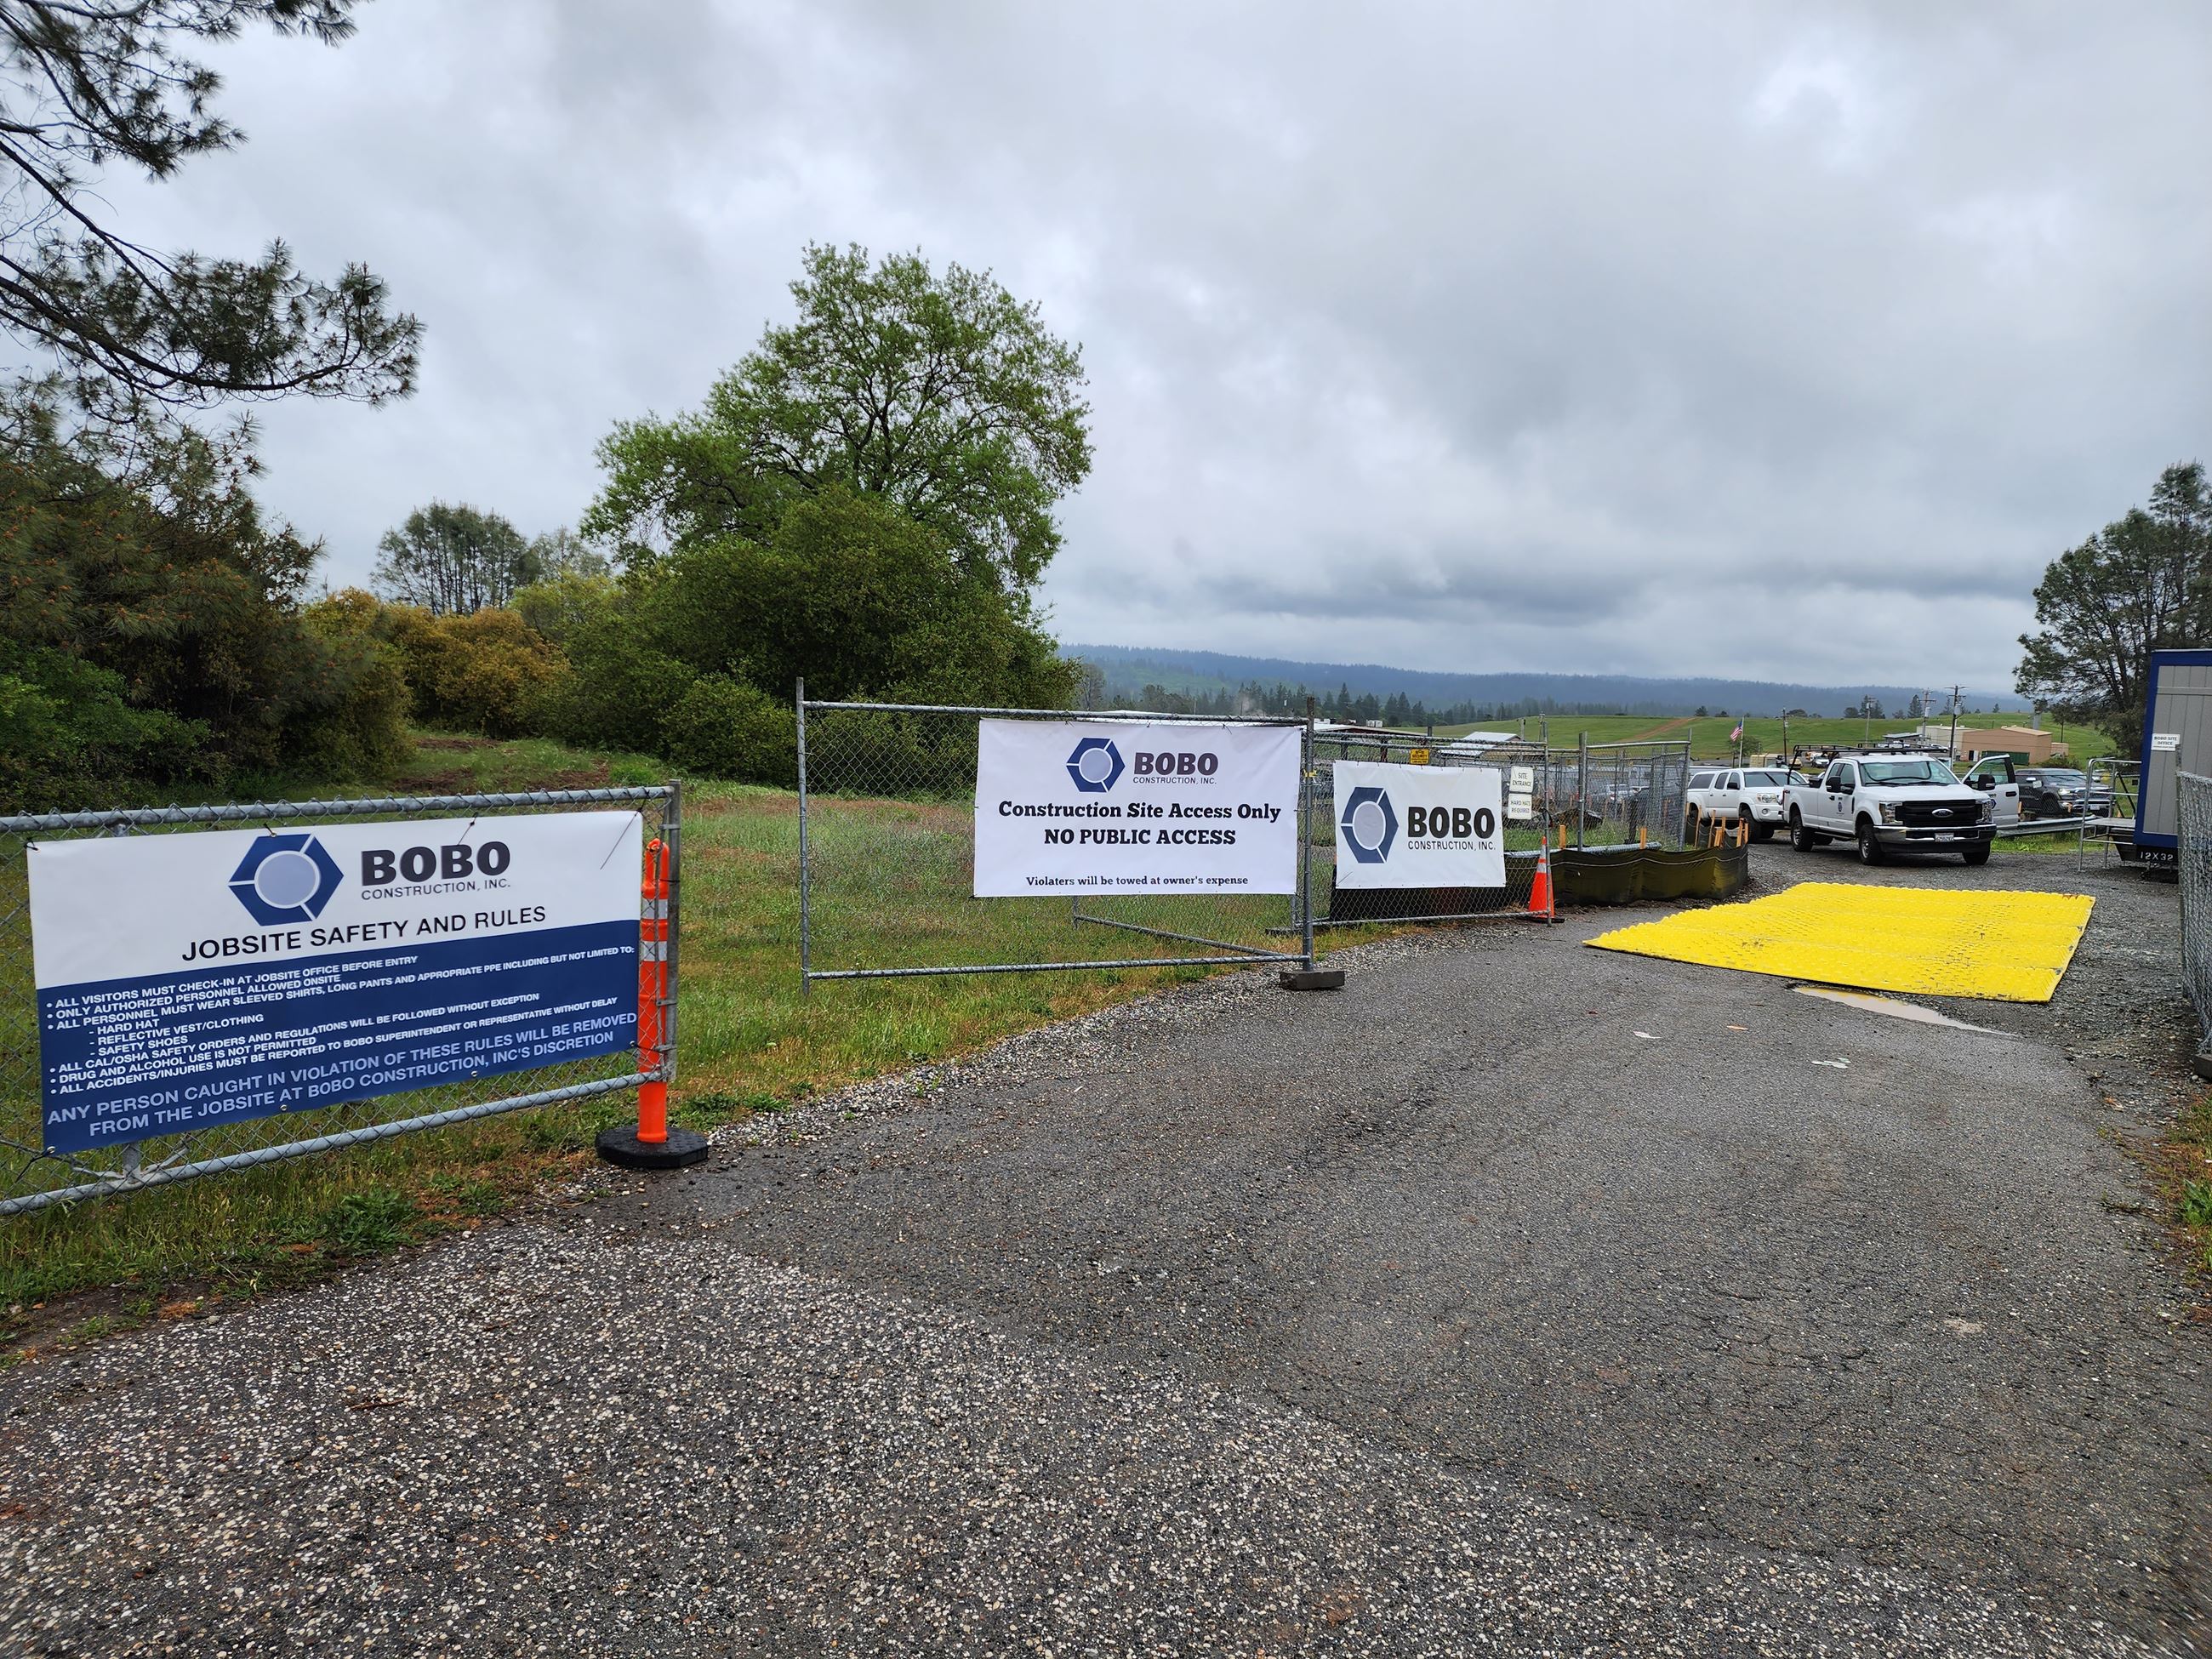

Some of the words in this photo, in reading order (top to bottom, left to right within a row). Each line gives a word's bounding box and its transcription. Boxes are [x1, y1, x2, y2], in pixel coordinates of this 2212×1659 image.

[1134, 752, 1218, 776] BOBO
[999, 801, 1122, 818] Construction
[1126, 801, 1164, 818] Site
[1168, 803, 1232, 818] Access
[1238, 803, 1281, 824] Only
[1408, 807, 1495, 839] BOBO
[1044, 829, 1075, 844] NO
[1080, 829, 1150, 844] PUBLIC
[1156, 830, 1236, 845] ACCESS
[1408, 841, 1477, 851] CONSTRUCTION,
[1479, 841, 1497, 850] INC.
[362, 841, 510, 887] BOBO
[2141, 852, 2174, 861] 12X32
[362, 881, 482, 901] CONSTRUCTION,
[484, 878, 511, 890] INC.
[1026, 876, 1075, 886] Violaters
[1077, 875, 1097, 885] will
[1100, 875, 1114, 885] be
[1116, 875, 1148, 885] towed
[1150, 876, 1160, 885] at
[1163, 875, 1203, 885] owner's
[1206, 877, 1248, 887] expense
[182, 931, 301, 961] JOBSITE
[311, 920, 408, 947] SAFETY
[416, 915, 466, 936] AND
[475, 905, 546, 929] RULES
[55, 998, 79, 1008] ALL
[82, 990, 139, 1004] VISITORS
[141, 985, 175, 997] MUST
[179, 978, 235, 992] CHECK-IN
[237, 976, 253, 985] AT
[255, 970, 300, 983] JOBSITE
[302, 965, 339, 977] OFFICE
[342, 961, 383, 972] BEFORE
[385, 955, 419, 966] ENTRY
[56, 1019, 80, 1030] ALL
[83, 1009, 157, 1026] PERSONNEL
[161, 1003, 194, 1016] MUST
[197, 999, 231, 1011] WEAR
[233, 992, 283, 1006] SLEEVED
[286, 986, 325, 999] SHIRTS,
[328, 982, 357, 993] LONG
[359, 977, 393, 989] PANTS
[394, 975, 415, 984] AND
[417, 966, 482, 982] APPROPRIATE
[484, 964, 502, 972] PPE
[503, 956, 549, 970] INCLUDING
[550, 955, 567, 963] BUT
[568, 952, 586, 961] NOT
[587, 947, 619, 958] LIMITED
[56, 1006, 91, 1019] ONLY
[94, 996, 173, 1014] AUTHORIZED
[176, 987, 244, 1003] PERSONNEL
[247, 981, 301, 993] ALLOWED
[303, 974, 341, 986] ONSITE
[59, 1063, 83, 1074] ALL
[85, 1052, 149, 1069] CAL/OSHA
[151, 1044, 197, 1059] SAFETY
[198, 1036, 246, 1052] ORDERS
[248, 1033, 272, 1043] AND
[275, 1021, 348, 1040] REGULATIONS
[350, 1018, 374, 1028] WILL
[376, 1015, 391, 1024] BE
[392, 1007, 446, 1022] FOLLOWED
[447, 1001, 490, 1014] WITHOUT
[490, 993, 540, 1007] EXCEPTION
[97, 1023, 132, 1035] HARD
[135, 1019, 160, 1029] HAT
[98, 1027, 171, 1046] REFLECTIVE
[173, 1014, 265, 1035] VEST/CLOTHING
[59, 1071, 96, 1084] DRUG
[100, 1066, 126, 1077] AND
[128, 1058, 186, 1073] ALCOHOL
[189, 1052, 212, 1063] USE
[214, 1050, 225, 1058] IS
[228, 1046, 251, 1056] NOT
[254, 1036, 316, 1052] PERMITTED
[60, 1084, 84, 1095] ALL
[86, 1062, 214, 1090] ACCIDENTS/INJURIES
[216, 1056, 248, 1069] MUST
[250, 1053, 265, 1063] BE
[268, 1045, 326, 1060] REPORTED
[327, 1042, 341, 1051] TO
[344, 1036, 373, 1048] BOBO
[375, 1023, 462, 1043] SUPERINTENDENT
[463, 1020, 477, 1029] OR
[479, 1007, 553, 1027] REPRESENTATIVE
[554, 1001, 591, 1013] WITHOUT
[591, 997, 618, 1008] DELAY
[98, 1041, 145, 1057] SAFETY
[148, 1035, 188, 1049] SHOES
[47, 1105, 90, 1125] ANY
[97, 1090, 179, 1116] PERSON
[184, 1075, 263, 1100] CAUGHT
[268, 1072, 285, 1086] IN
[290, 1056, 379, 1082] VIOLATION
[384, 1051, 407, 1066] OF
[410, 1043, 461, 1062] THESE
[465, 1035, 513, 1052] RULES
[516, 1029, 549, 1043] WILL
[552, 1023, 570, 1036] BE
[573, 1012, 637, 1033] REMOVED
[89, 1114, 149, 1137] FROM
[154, 1106, 193, 1124] THE
[198, 1092, 275, 1117] JOBSITE
[279, 1087, 303, 1102] AT
[308, 1077, 355, 1097] BOBO
[359, 1055, 489, 1086] CONSTRUCTION,
[493, 1046, 530, 1063] INC'S
[533, 1031, 613, 1056] DISCRETION
